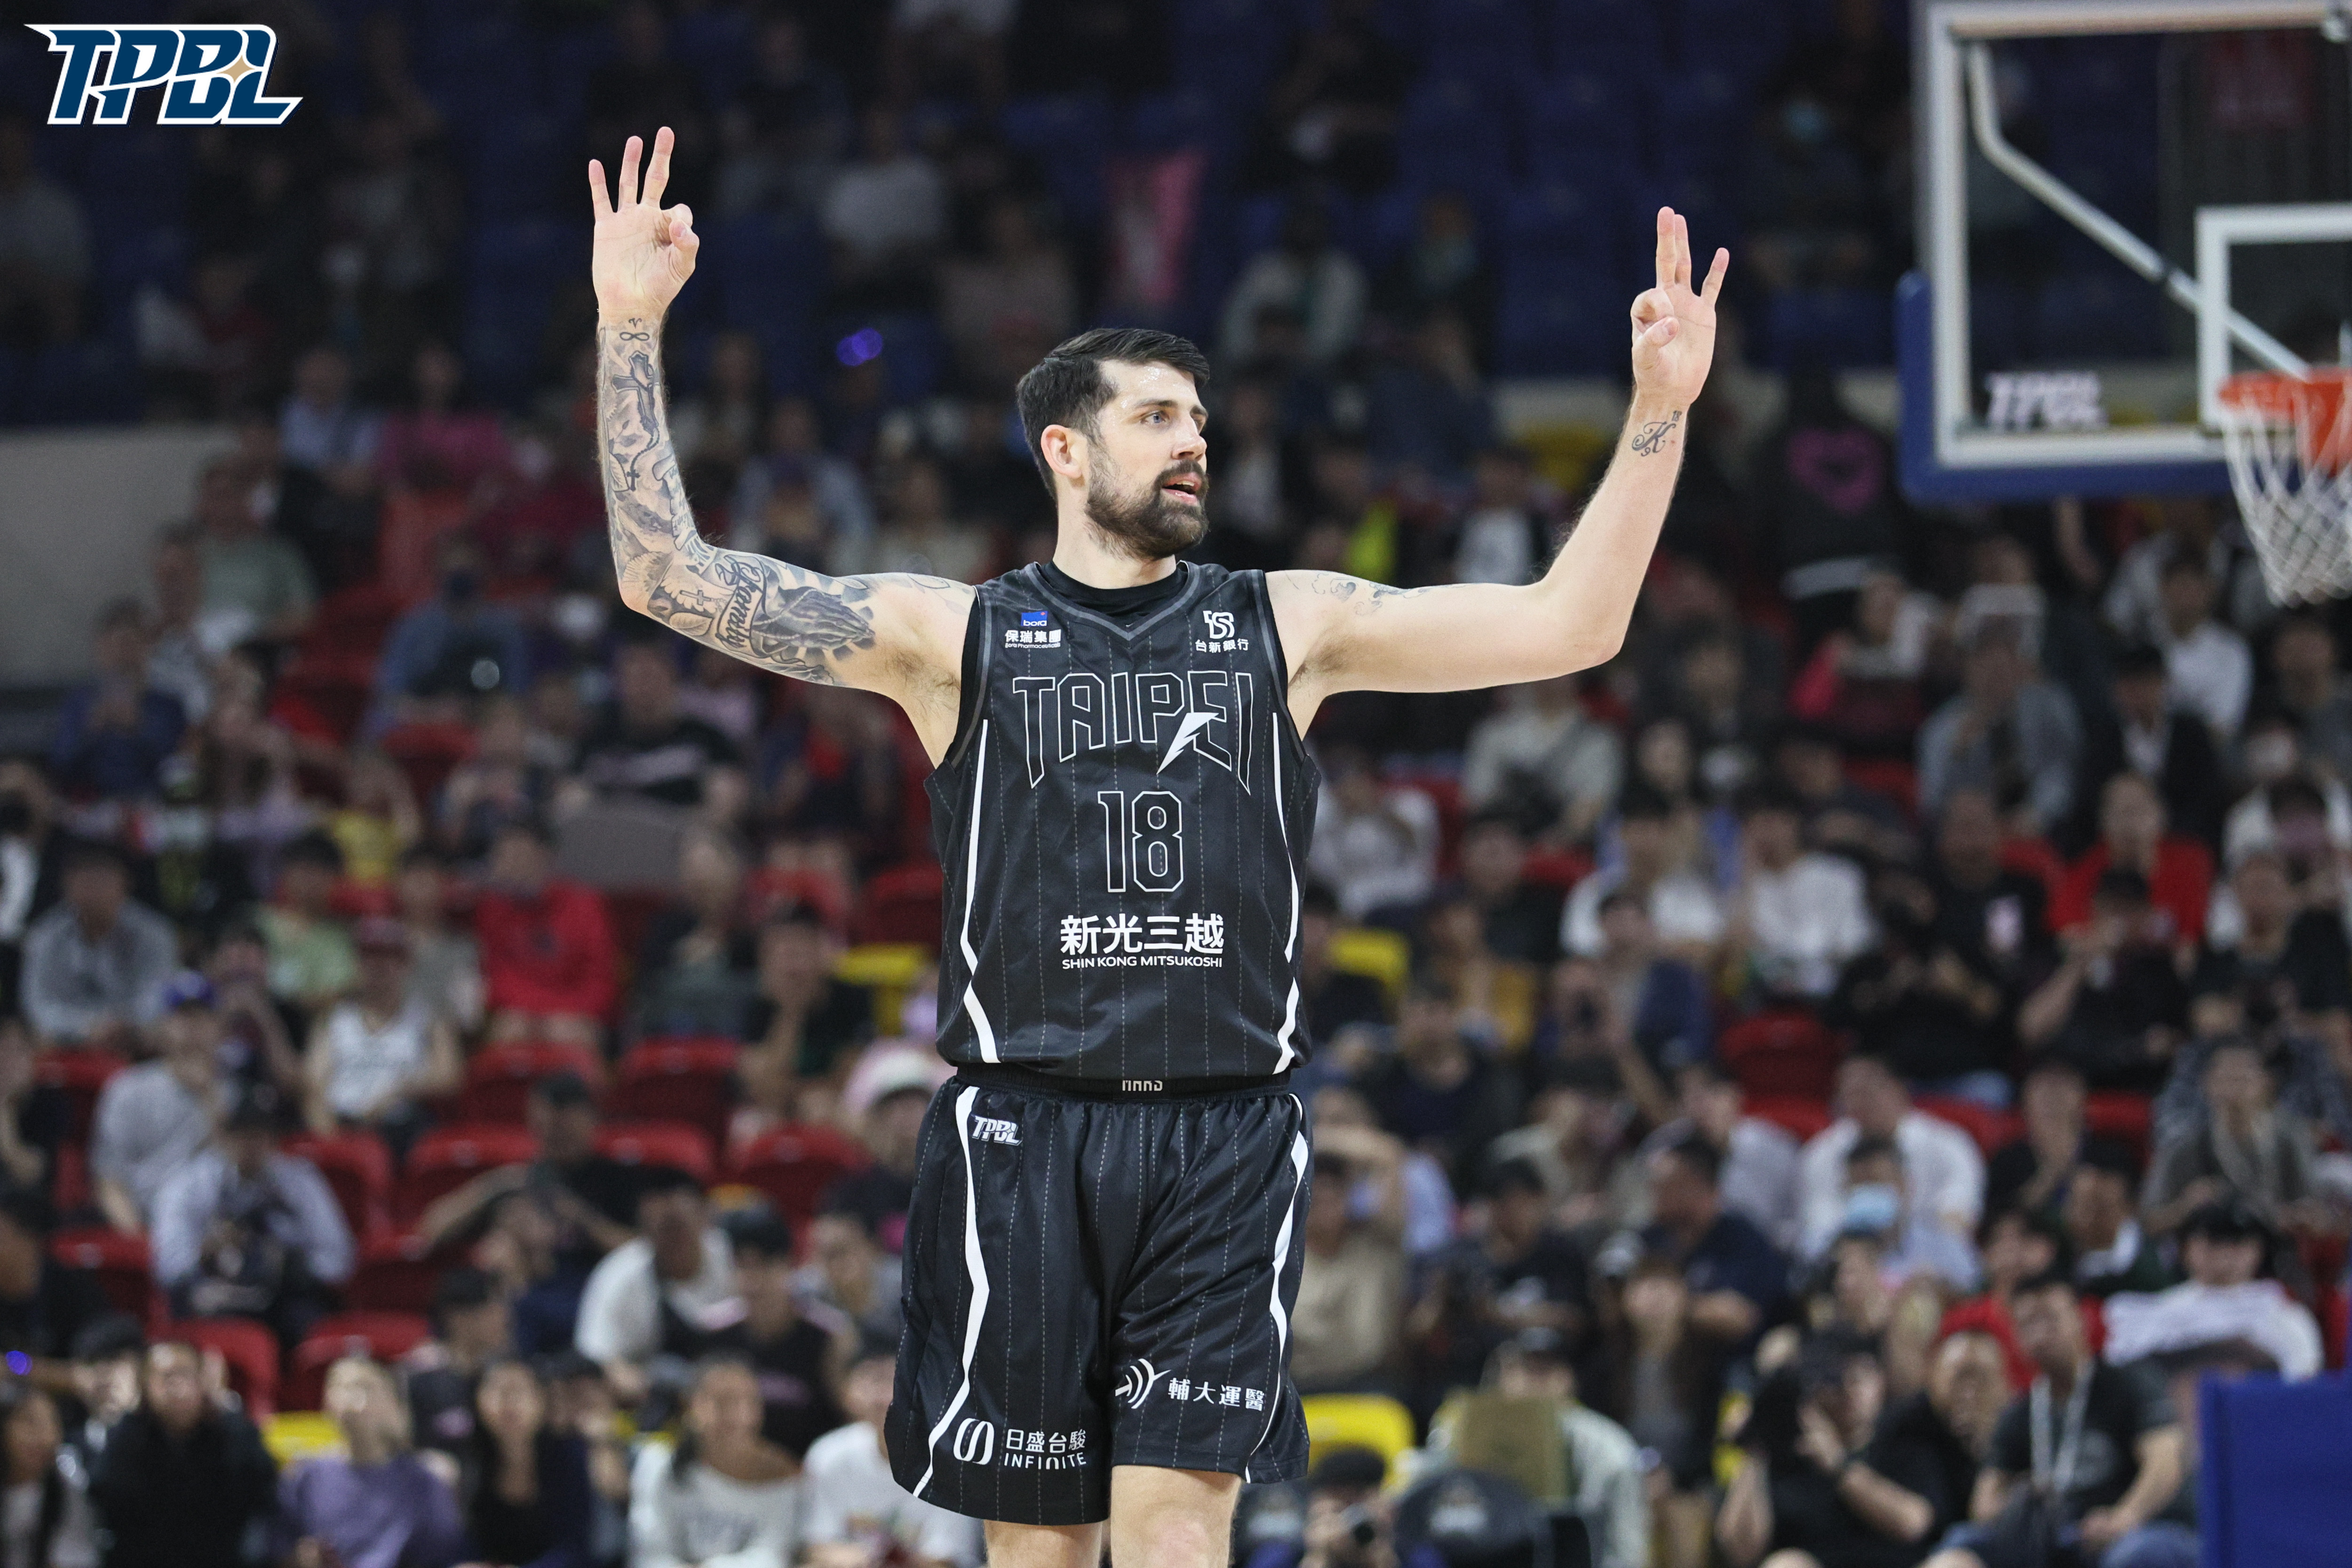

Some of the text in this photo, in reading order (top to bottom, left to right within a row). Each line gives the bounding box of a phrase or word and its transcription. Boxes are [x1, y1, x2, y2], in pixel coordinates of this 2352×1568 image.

[1005, 629, 1062, 643] 保瑞集團
[1195, 638, 1249, 653] 台新銀行
[1012, 670, 1254, 796] TAIPEI
[1097, 790, 1184, 892] 18
[1060, 913, 1224, 955] 新光三越
[1062, 955, 1223, 970] SHIN KONG MITSUKOSHI
[971, 1114, 1023, 1146] TPBL
[1168, 1377, 1265, 1411] 輔大運醫
[1006, 1428, 1087, 1453] 日盛台駿
[1003, 1452, 1087, 1470] INFINITE
